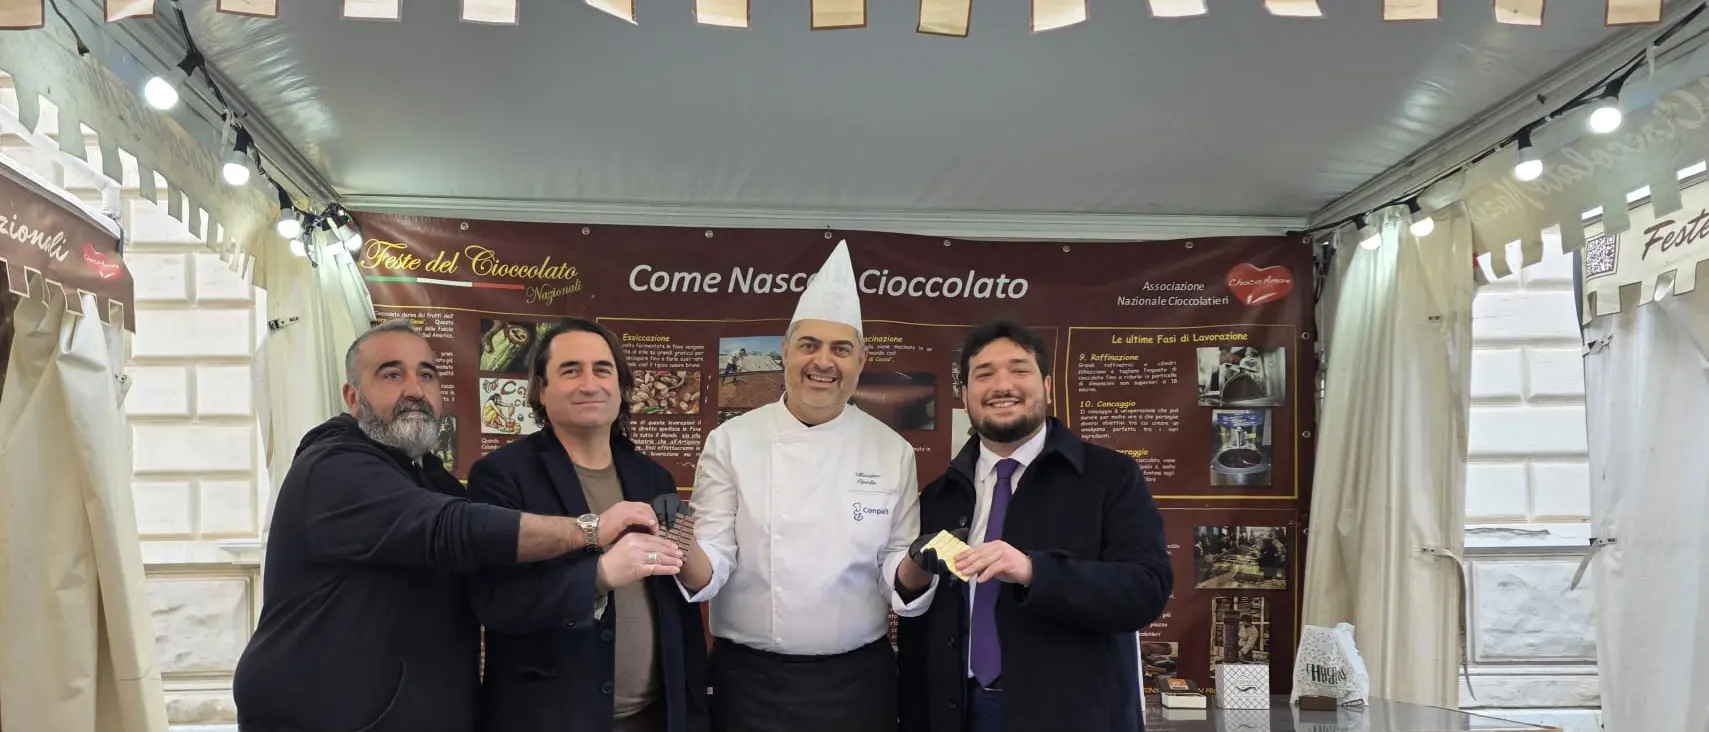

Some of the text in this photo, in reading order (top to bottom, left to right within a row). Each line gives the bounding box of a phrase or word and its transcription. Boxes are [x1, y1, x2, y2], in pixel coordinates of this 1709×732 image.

[0, 214, 69, 262] zionali
[360, 238, 580, 280] Feste del Cioccolato
[629, 264, 722, 293] Come
[859, 269, 1028, 299] Cioccolato
[1142, 281, 1205, 291] Associazione
[526, 279, 583, 306] Nazionali
[1117, 296, 1229, 306] Nazionale Cioccolatieri
[622, 333, 670, 342] Essiccazione
[863, 335, 903, 343] acinazione
[1112, 332, 1249, 344] Le ultime Fasi di Lavorazione
[1091, 353, 1139, 361] Raffinazione
[1097, 400, 1136, 408] Concaggio
